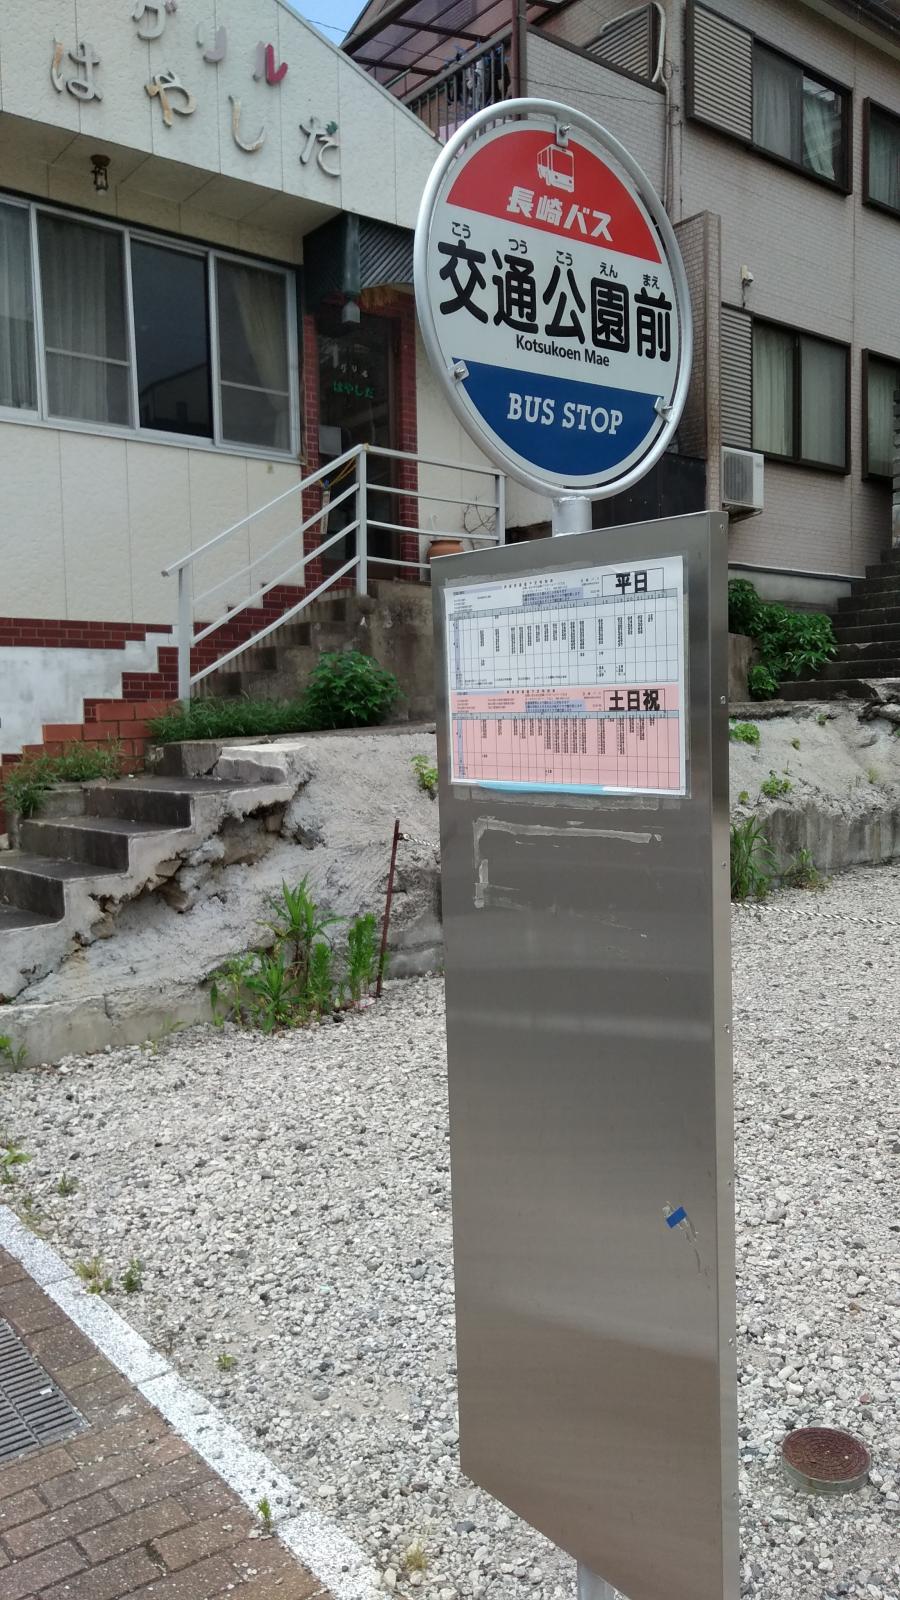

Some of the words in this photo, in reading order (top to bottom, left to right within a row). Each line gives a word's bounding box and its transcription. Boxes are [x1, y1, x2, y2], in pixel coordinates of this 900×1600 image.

[132, 0, 288, 86] グリル
[51, 37, 341, 177] はやしだ
[507, 185, 614, 242] 長崎バス
[452, 222, 472, 239] こう
[508, 239, 528, 254] つう
[556, 251, 574, 266] こう
[600, 262, 618, 279] えん
[643, 274, 660, 290] まえ
[437, 239, 673, 362] 交通公園前
[516, 334, 581, 361] Kotsukoen
[584, 349, 610, 367] Mae
[507, 392, 555, 426] BUS
[562, 402, 623, 435] STOP
[615, 570, 648, 595] 平日
[608, 689, 661, 711] 土日祝
